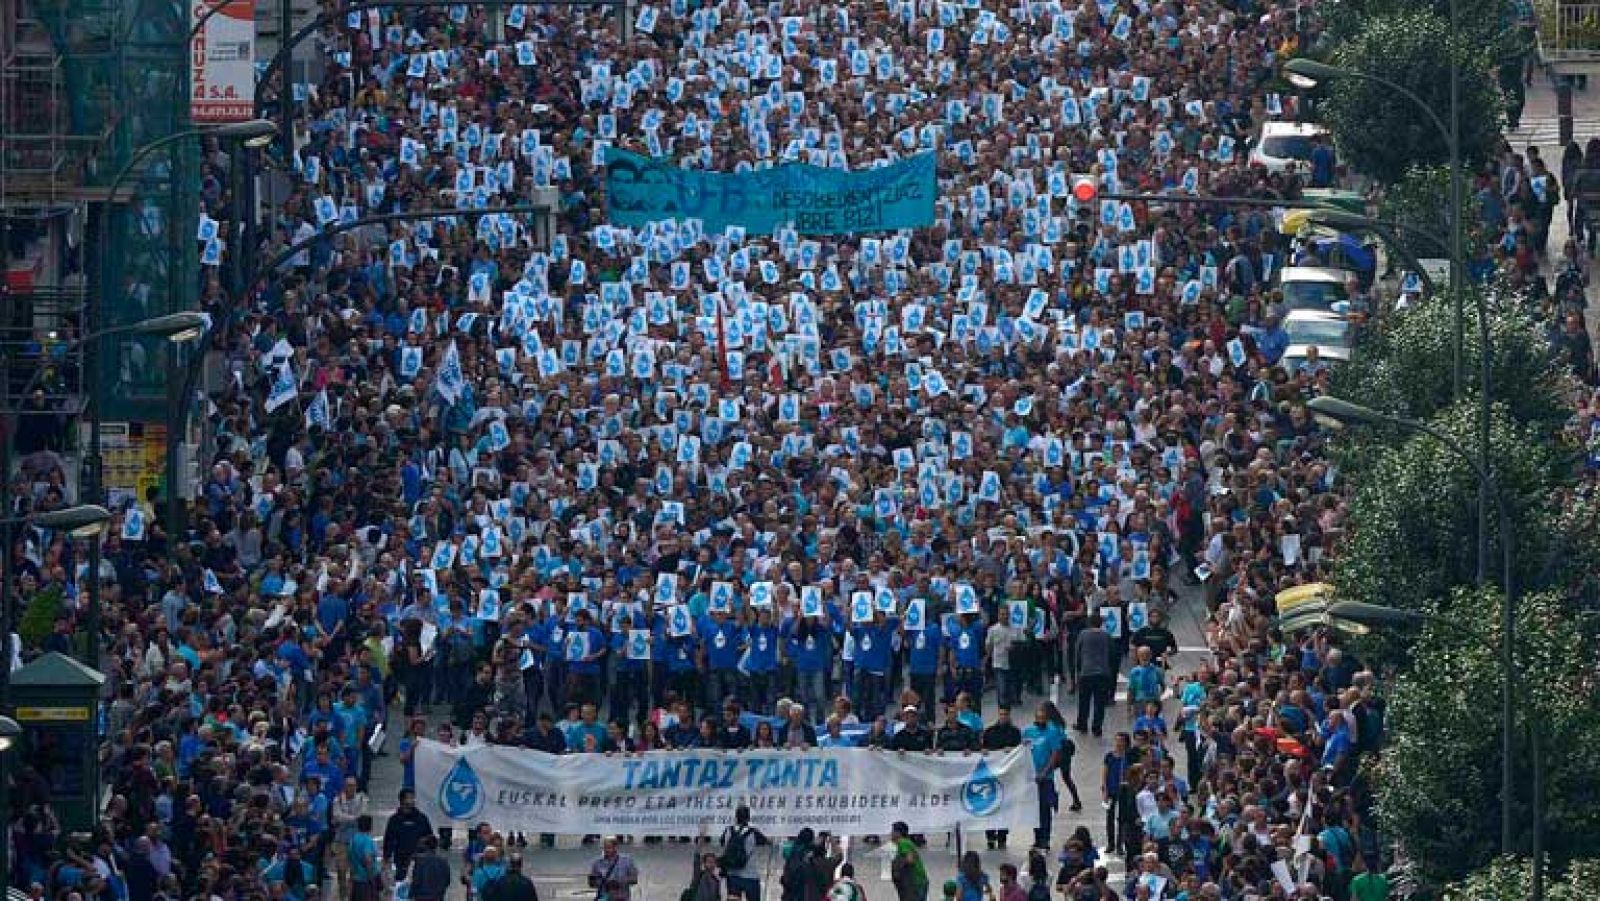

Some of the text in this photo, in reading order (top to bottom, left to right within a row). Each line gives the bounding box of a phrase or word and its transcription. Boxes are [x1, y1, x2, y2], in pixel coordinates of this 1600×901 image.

[622, 757, 840, 790] TANTAZ TANTA
[497, 789, 566, 808] EUSKAL
[578, 795, 637, 808] PRESO
[645, 795, 676, 809] ETA
[795, 794, 900, 809] ESKUBIDEEN
[908, 793, 951, 807] ALDE
